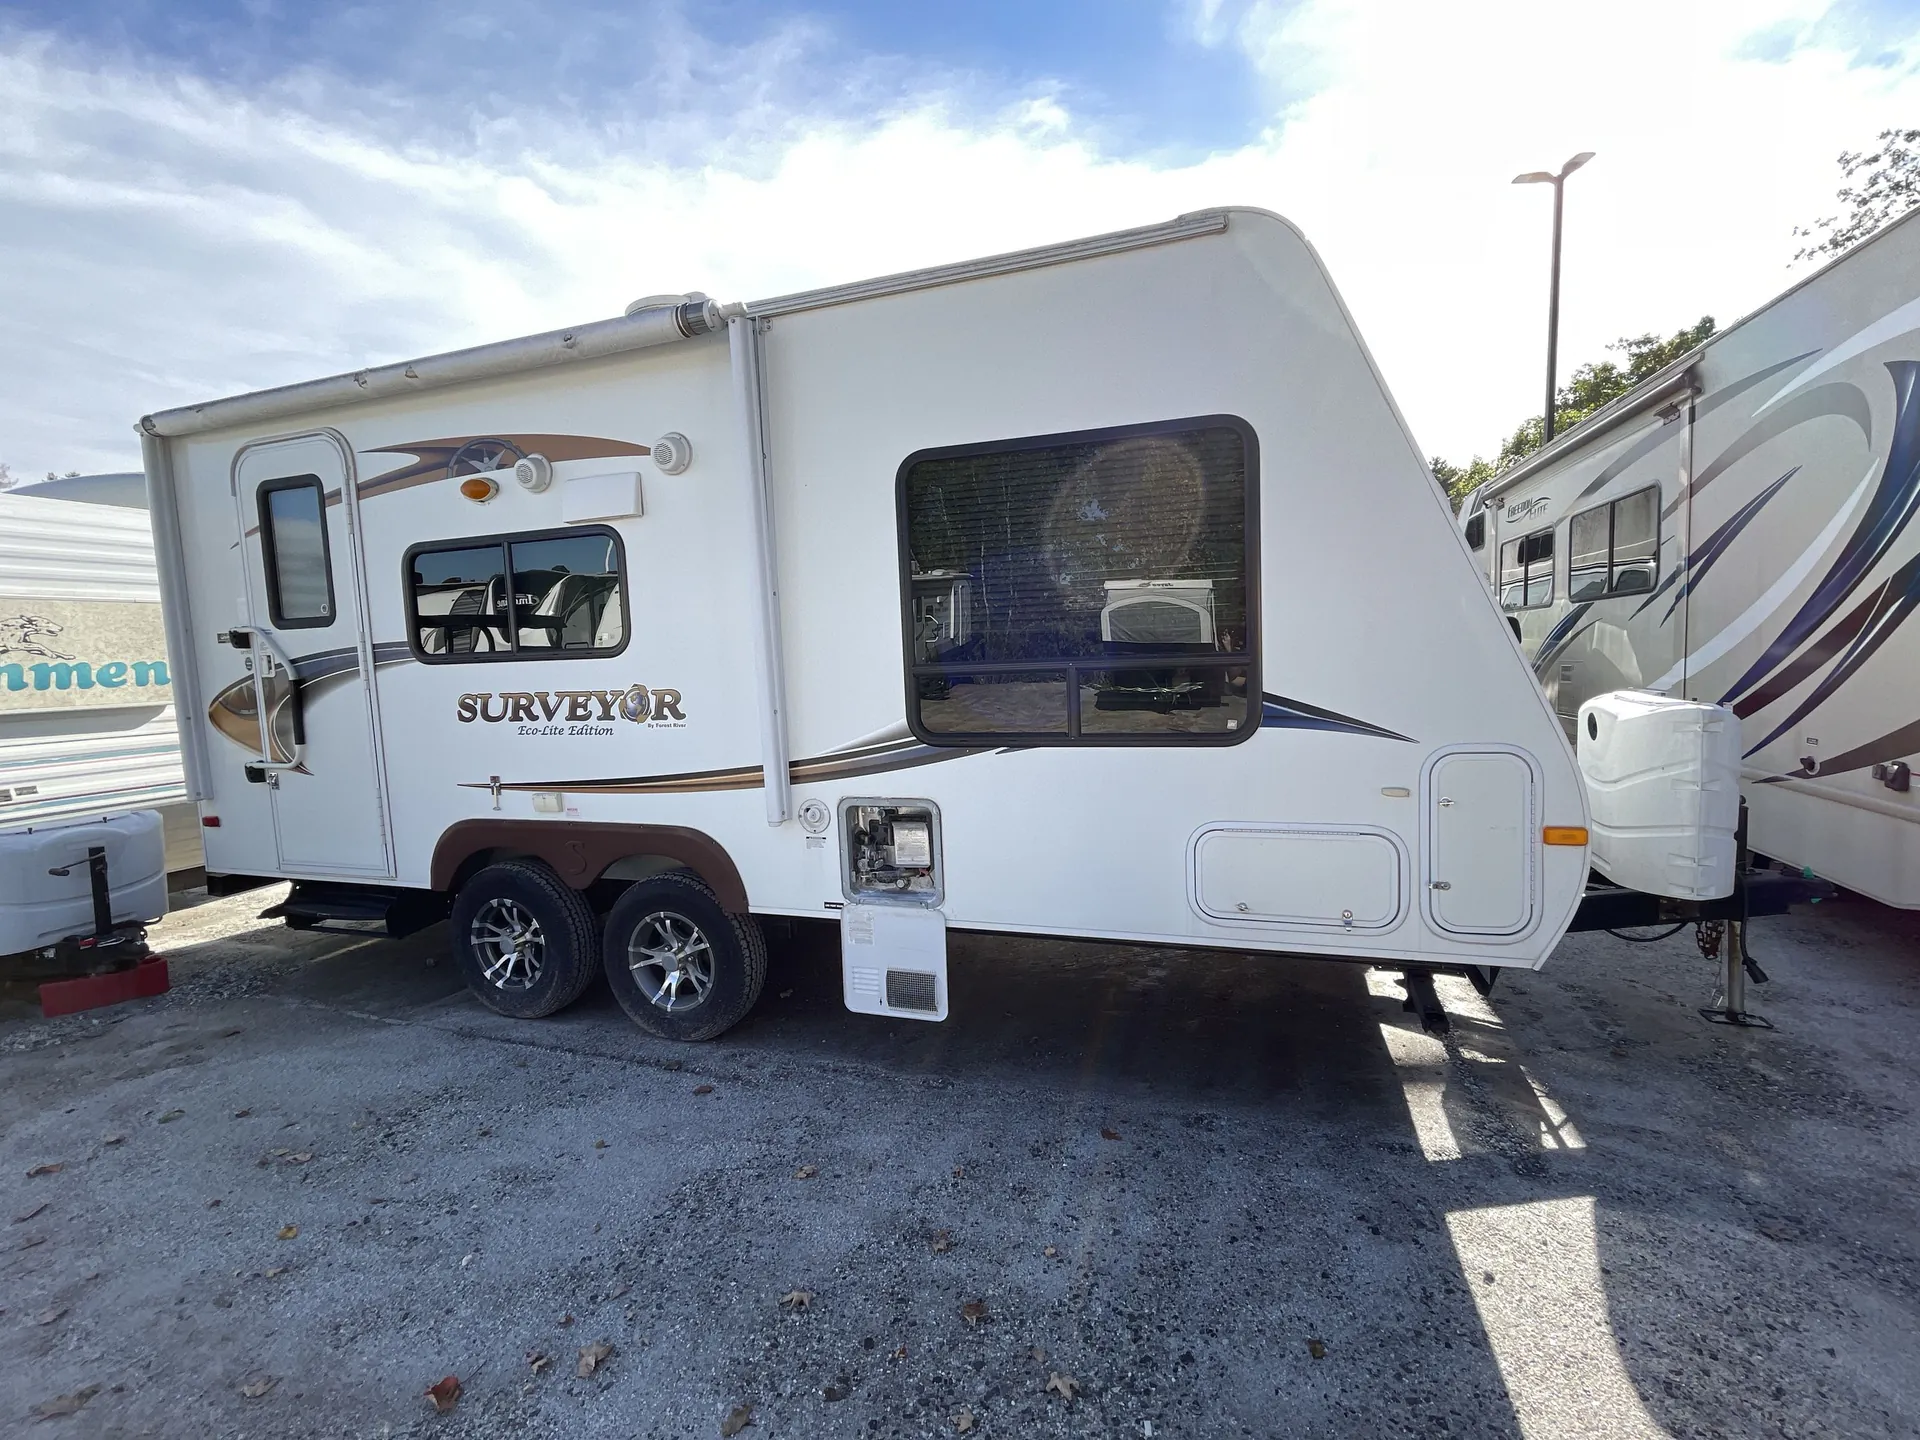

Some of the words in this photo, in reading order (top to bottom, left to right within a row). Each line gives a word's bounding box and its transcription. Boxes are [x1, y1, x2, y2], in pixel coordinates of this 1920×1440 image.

[457, 684, 687, 723] SURVEYOR
[517, 725, 565, 736] Eco-Lite
[568, 725, 614, 736] Edition
